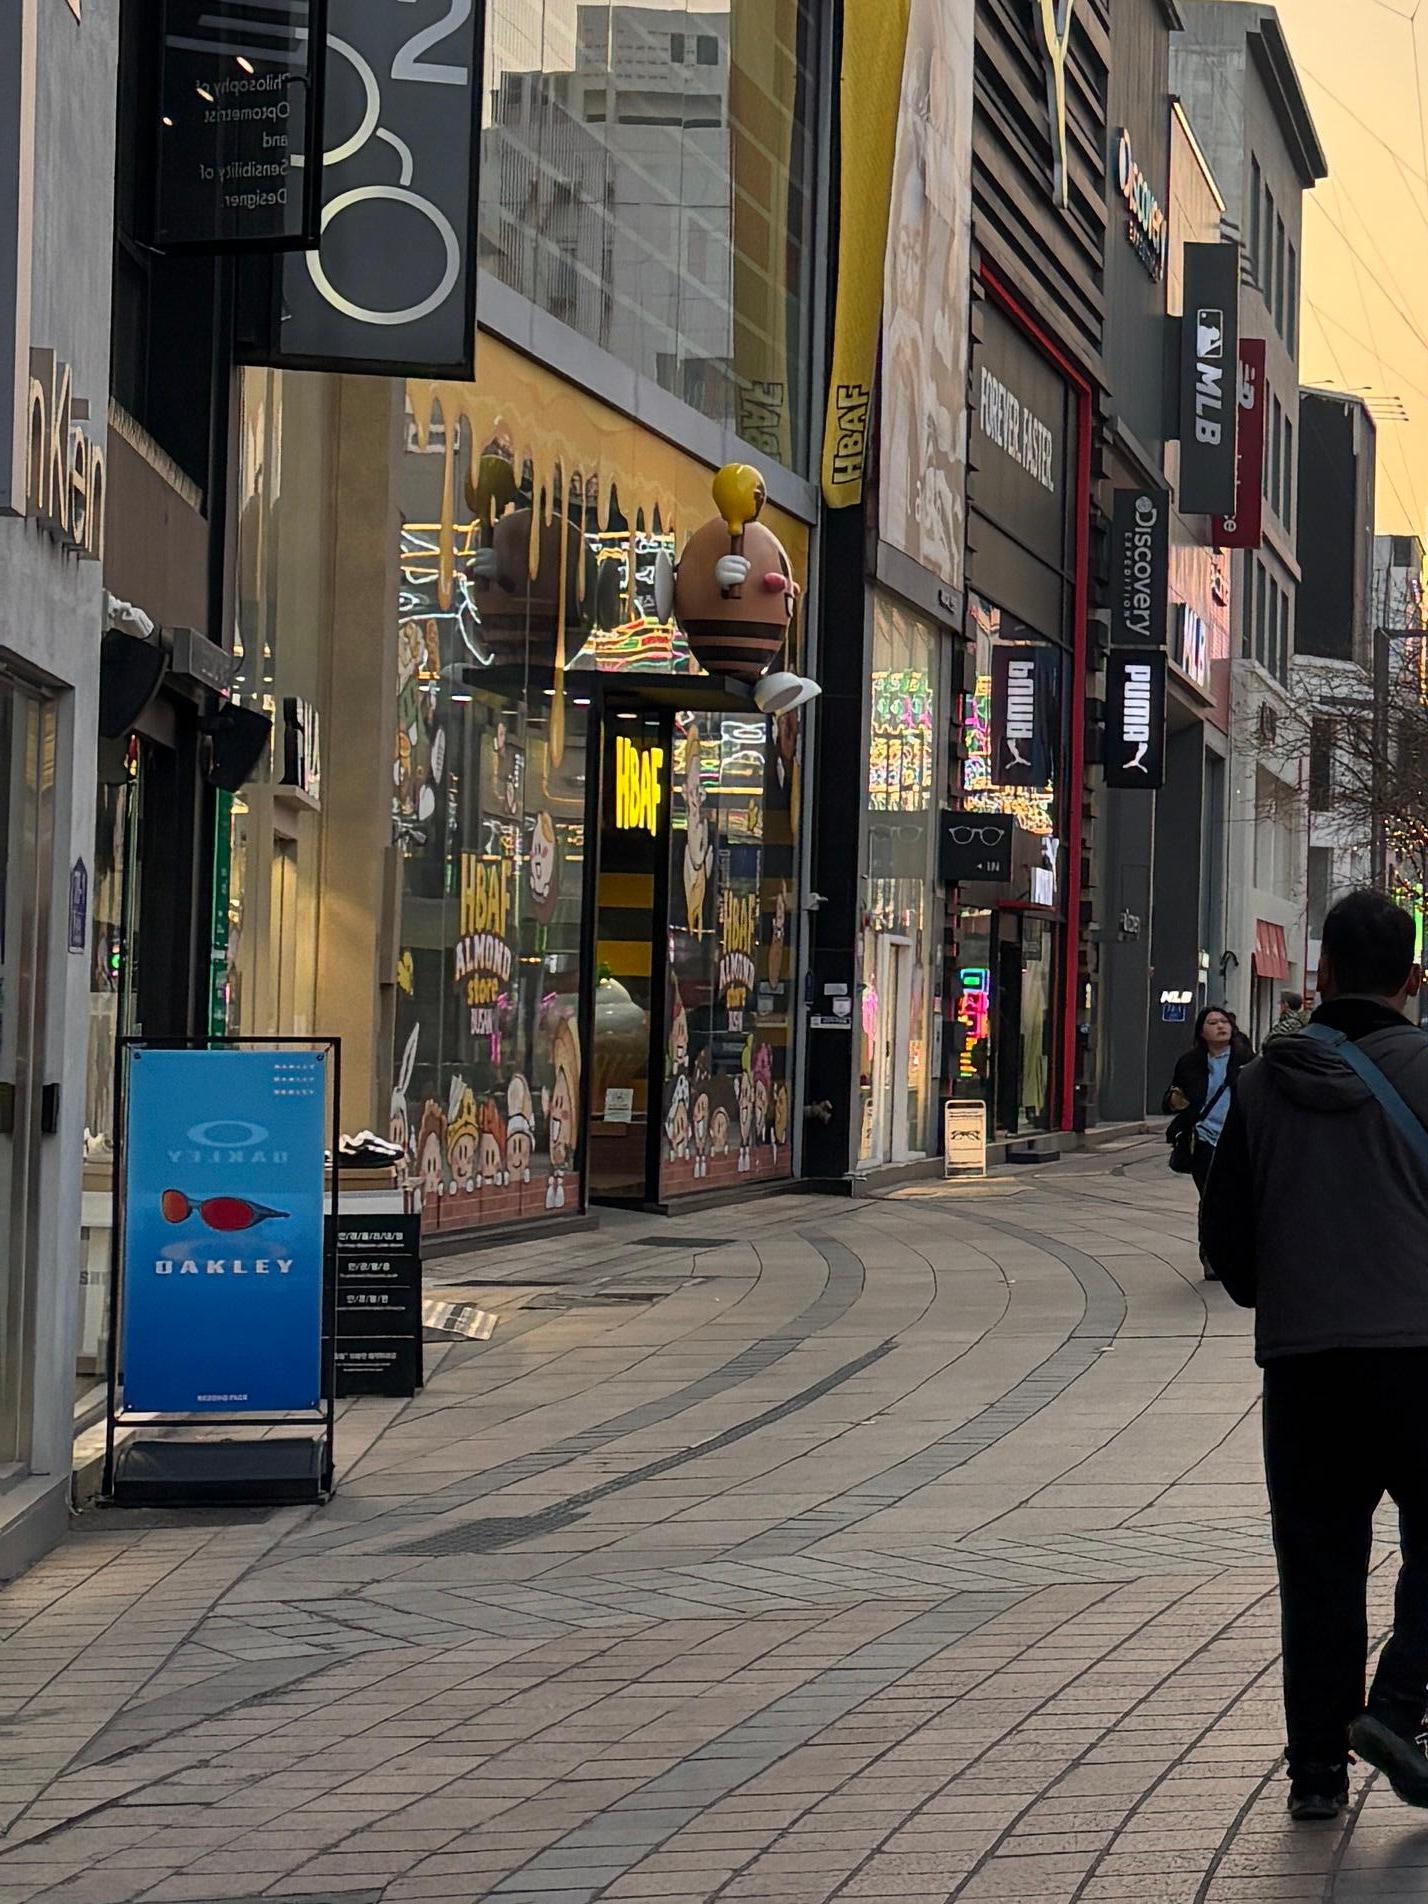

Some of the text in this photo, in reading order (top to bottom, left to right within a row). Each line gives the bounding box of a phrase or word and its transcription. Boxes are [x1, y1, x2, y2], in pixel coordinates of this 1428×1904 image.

[832, 384, 869, 486] HBAF
[1195, 362, 1223, 446] MLB
[1123, 664, 1150, 741] PUMA
[615, 736, 663, 837] HBAF
[460, 853, 511, 937] HBAF
[455, 934, 511, 982] ALMOND
[467, 975, 499, 1005] store
[155, 1259, 294, 1276] OAKLEY
